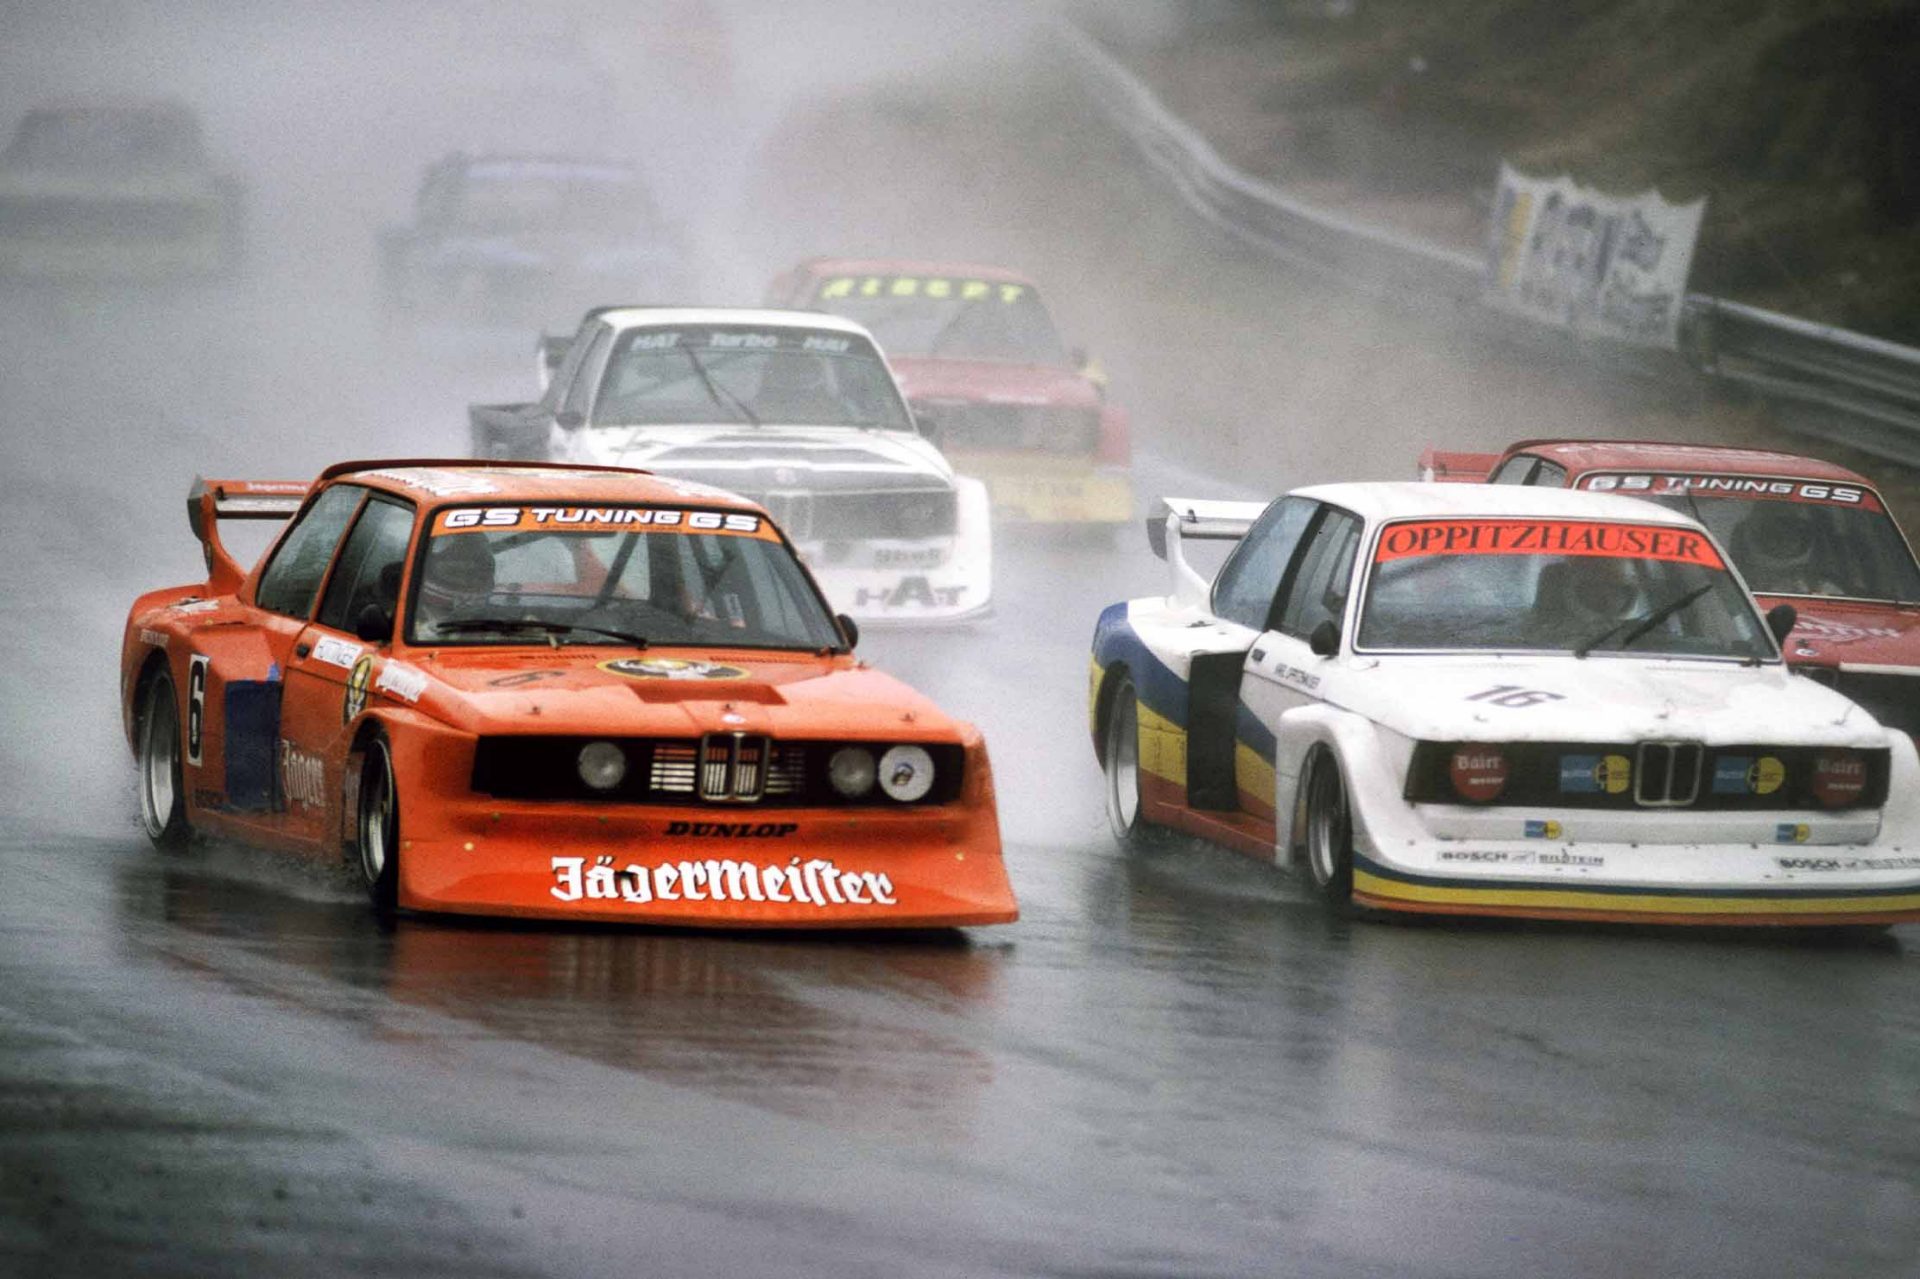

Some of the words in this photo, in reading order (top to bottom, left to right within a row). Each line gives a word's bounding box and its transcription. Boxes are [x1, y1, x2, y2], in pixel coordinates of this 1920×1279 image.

[1587, 475, 1651, 491] GS
[1665, 476, 1794, 494] TUNING
[1800, 485, 1862, 502] GS
[444, 508, 520, 527] GS
[531, 507, 681, 525] TUNING
[688, 512, 758, 531] GS
[1386, 524, 1701, 559] OPPITZHAUSER
[855, 576, 968, 606] HAT
[1465, 685, 1565, 709] 16
[188, 660, 205, 760] 6
[664, 821, 799, 838] DUNLOP
[1441, 851, 1508, 863] BOSCH
[1779, 858, 1842, 872] BOSCH
[550, 855, 897, 906] Jägermeister
